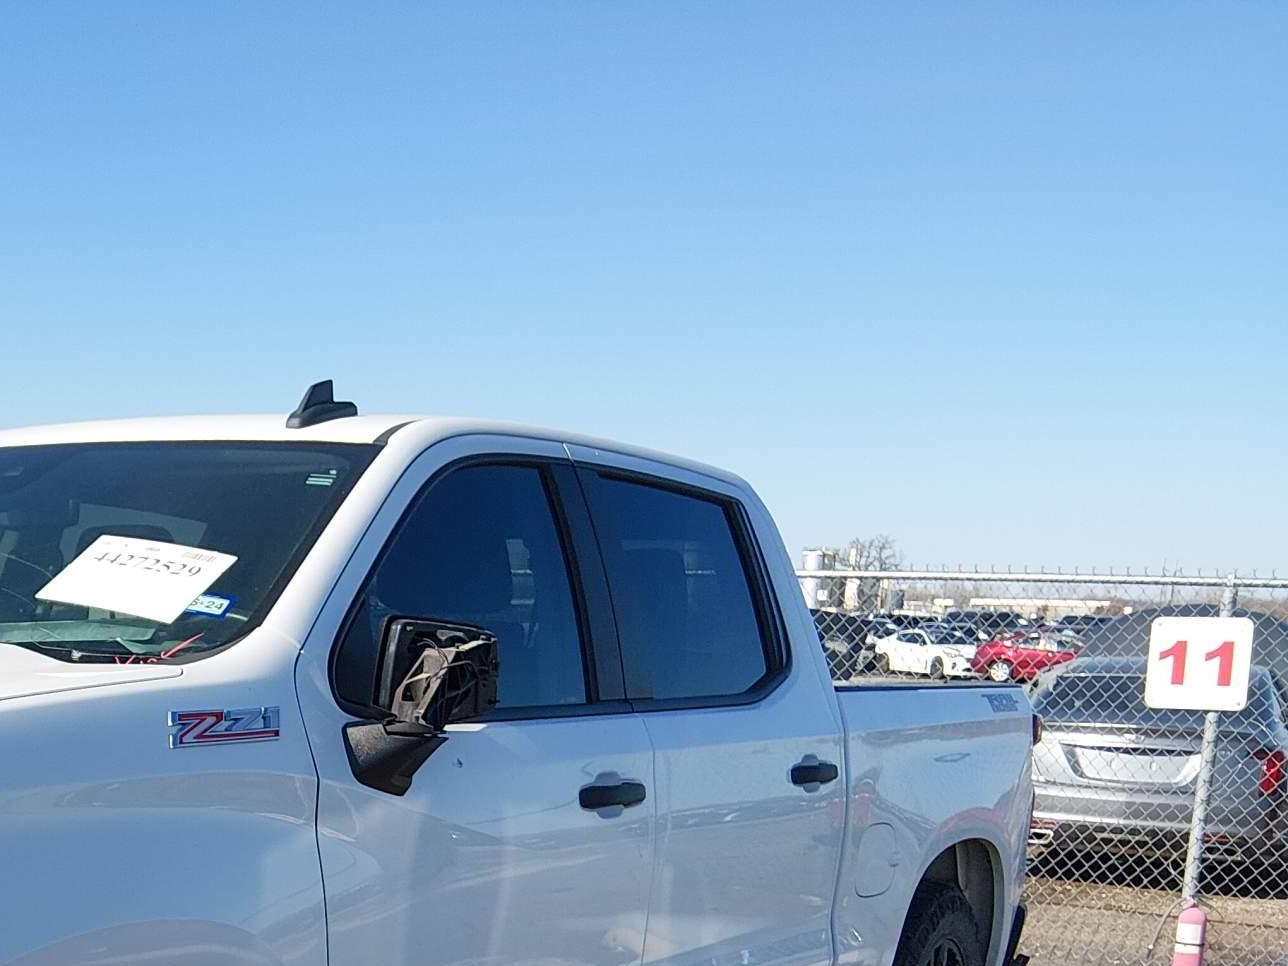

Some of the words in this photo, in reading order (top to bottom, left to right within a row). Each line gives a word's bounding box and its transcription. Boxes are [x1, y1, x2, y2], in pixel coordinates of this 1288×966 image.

[93, 551, 203, 577] 44272529
[1158, 640, 1235, 687] 11
[168, 706, 280, 748] Z71
